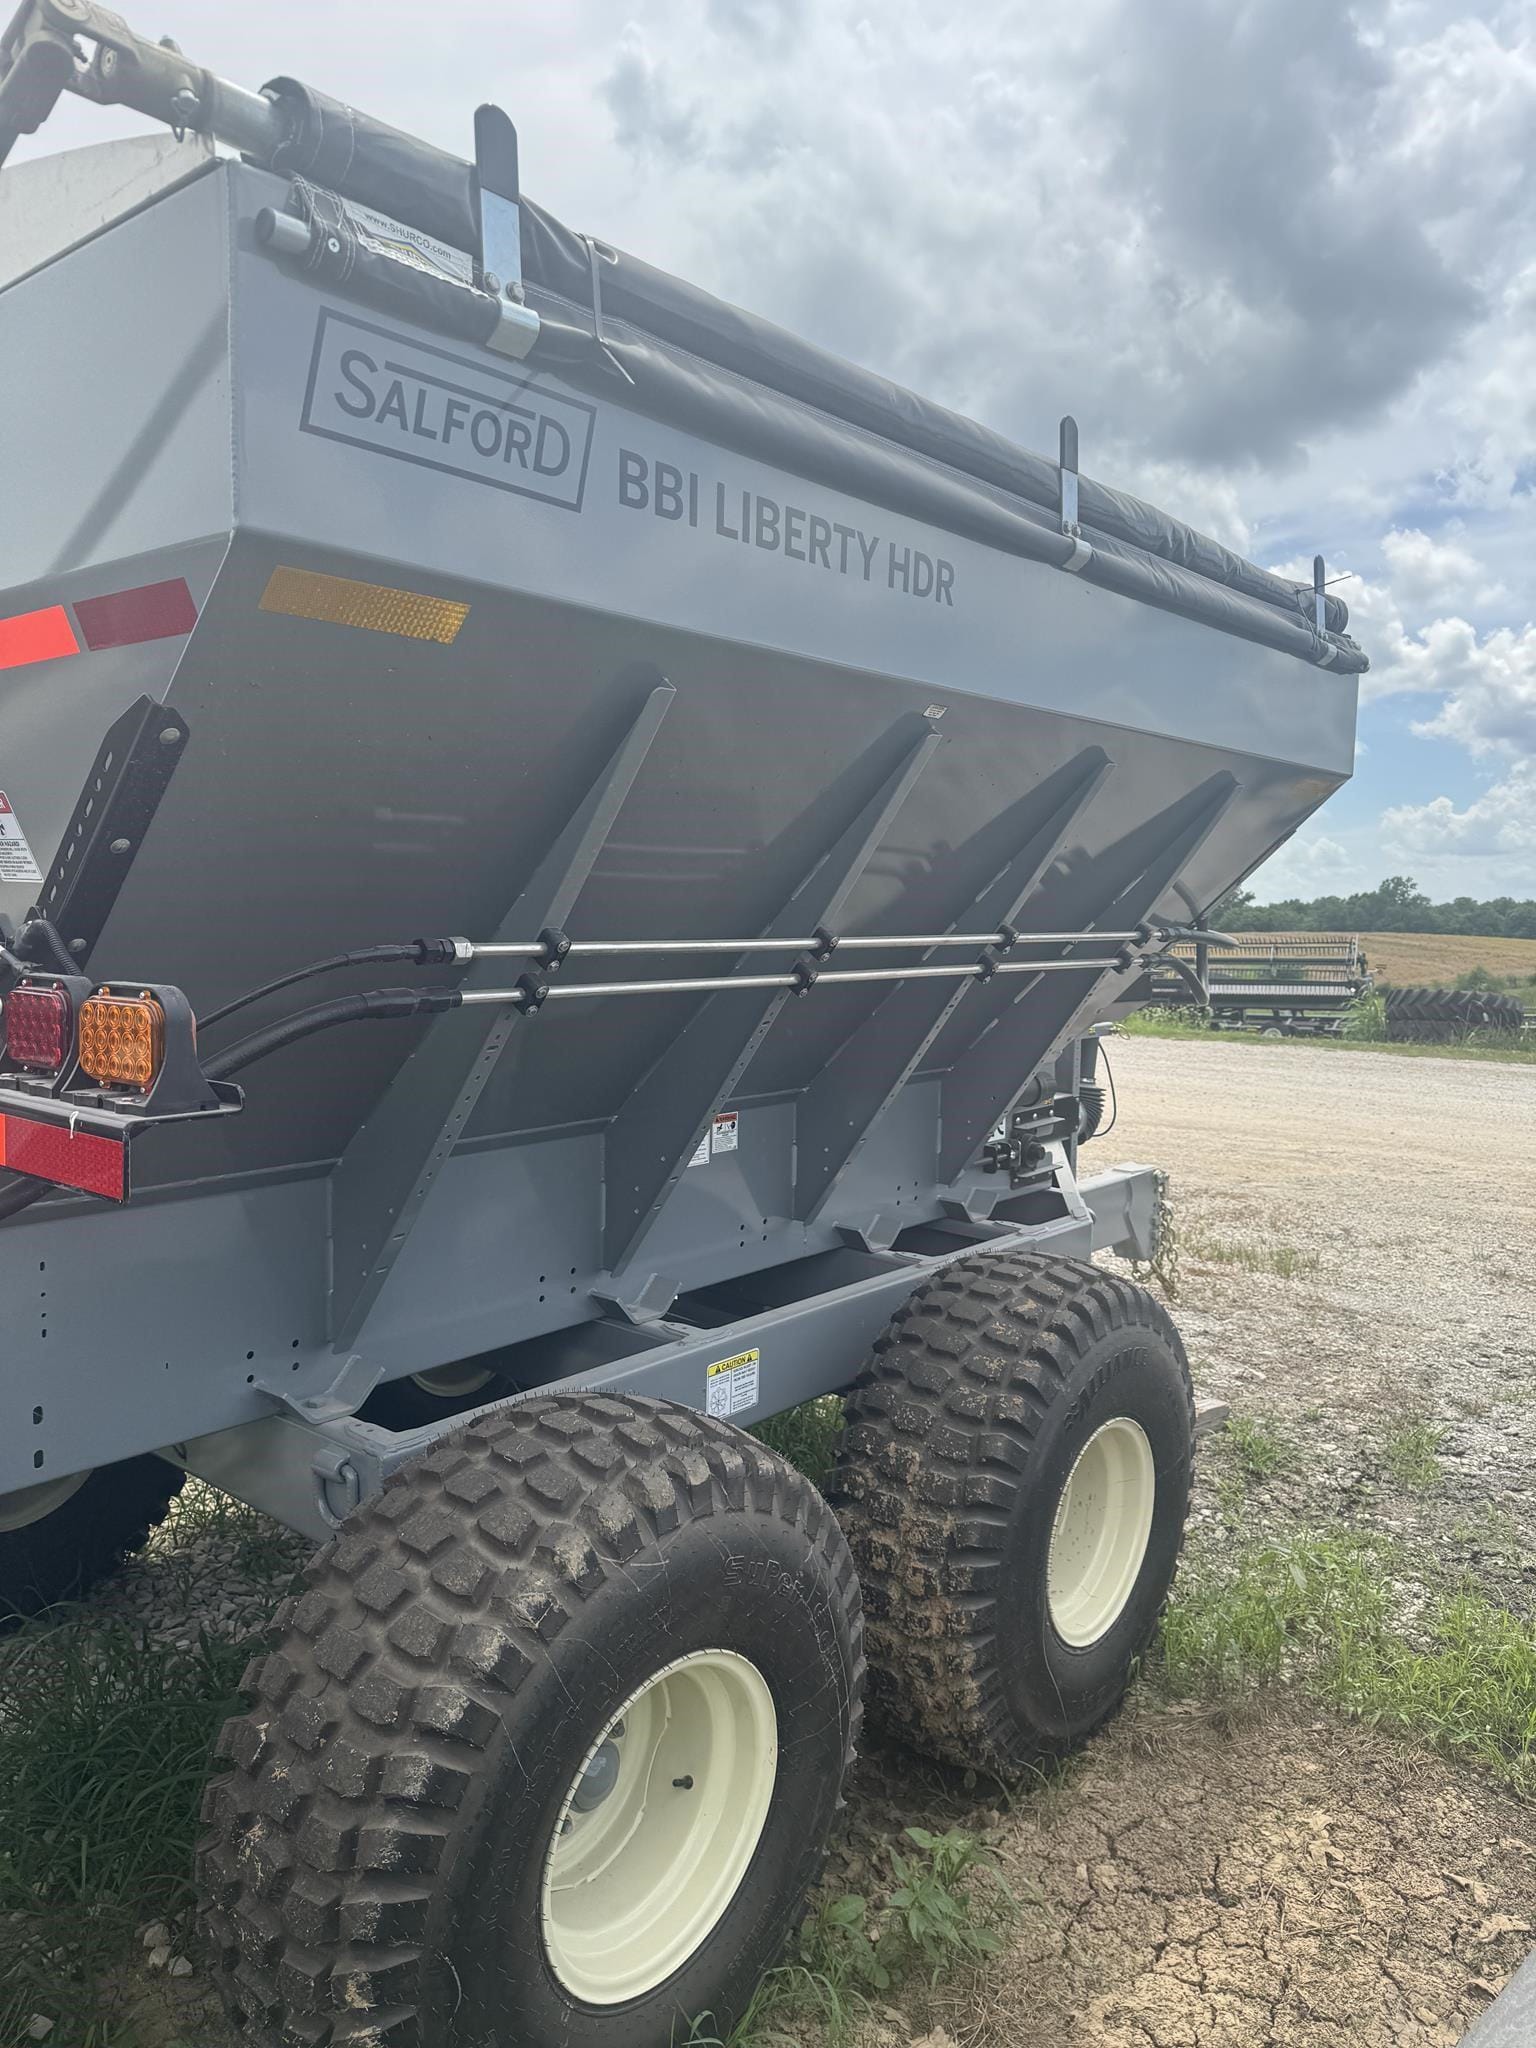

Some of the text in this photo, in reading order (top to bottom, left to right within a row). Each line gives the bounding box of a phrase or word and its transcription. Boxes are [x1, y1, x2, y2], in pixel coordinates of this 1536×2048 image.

[366, 214, 452, 259] www.SHURCO.com
[333, 348, 571, 478] SALFORD
[617, 447, 956, 607] BBI LIBERTY HDR
[721, 1355, 746, 1371] CAUTION
